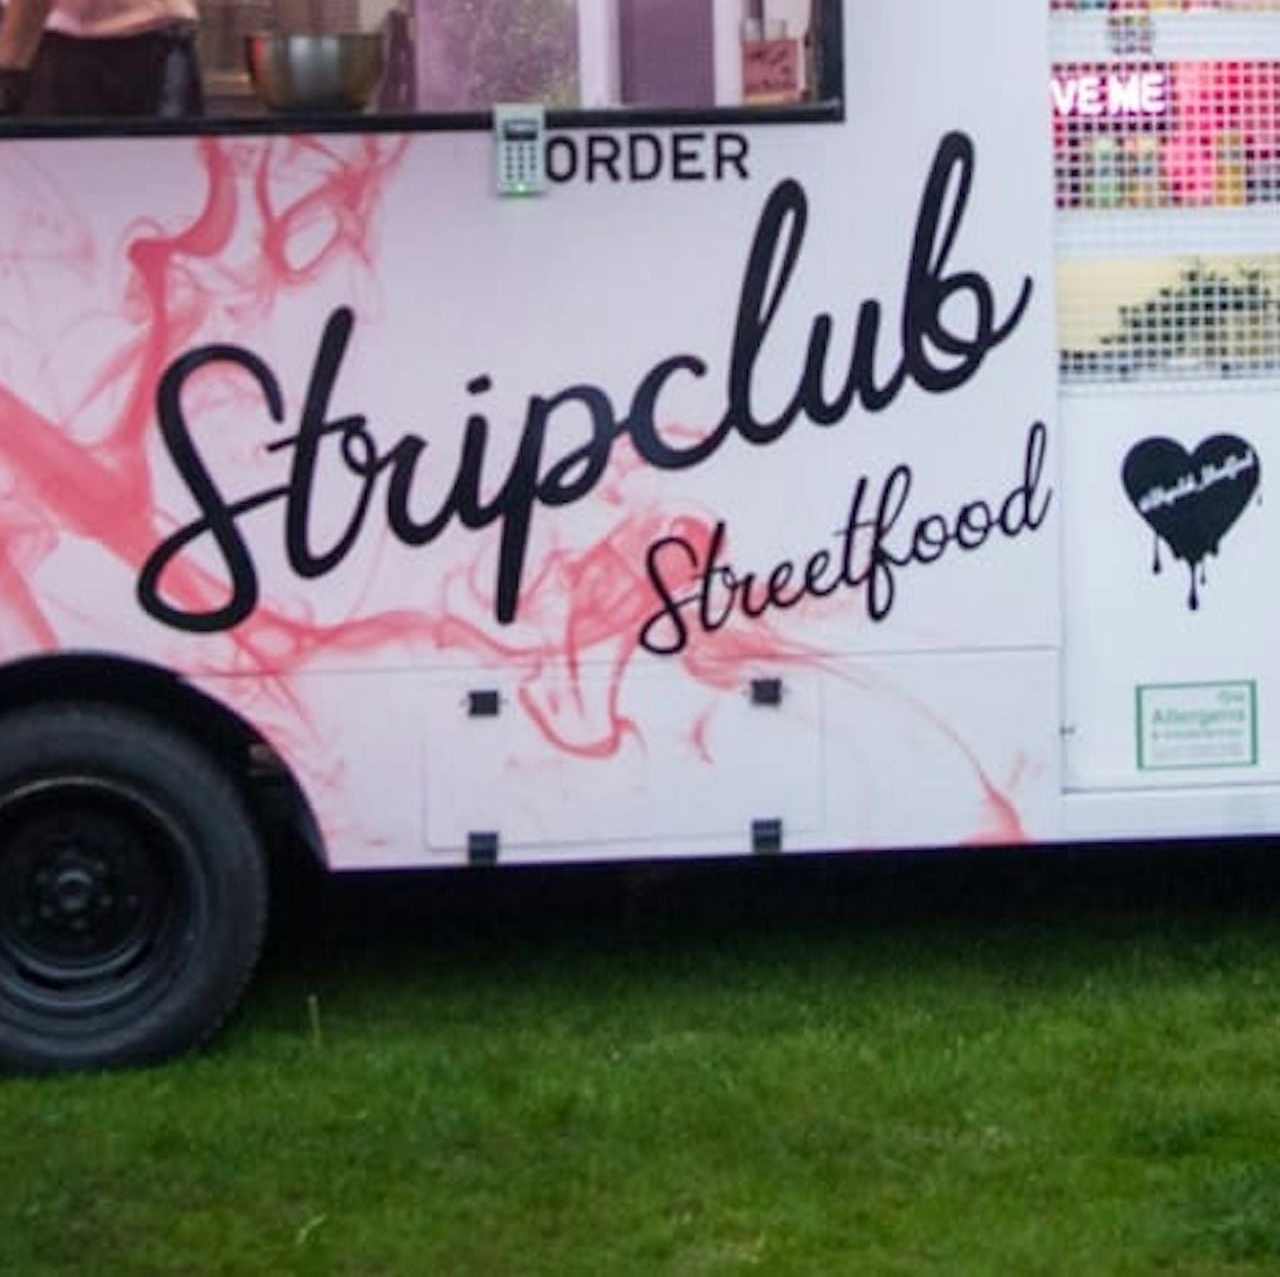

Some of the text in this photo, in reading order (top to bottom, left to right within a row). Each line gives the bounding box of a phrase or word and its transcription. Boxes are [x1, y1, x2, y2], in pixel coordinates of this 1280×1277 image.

[544, 132, 750, 184] ORDER
[1108, 74, 1166, 114] ME
[136, 131, 1034, 634] Stripclub
[637, 421, 1054, 656] Streetfood
